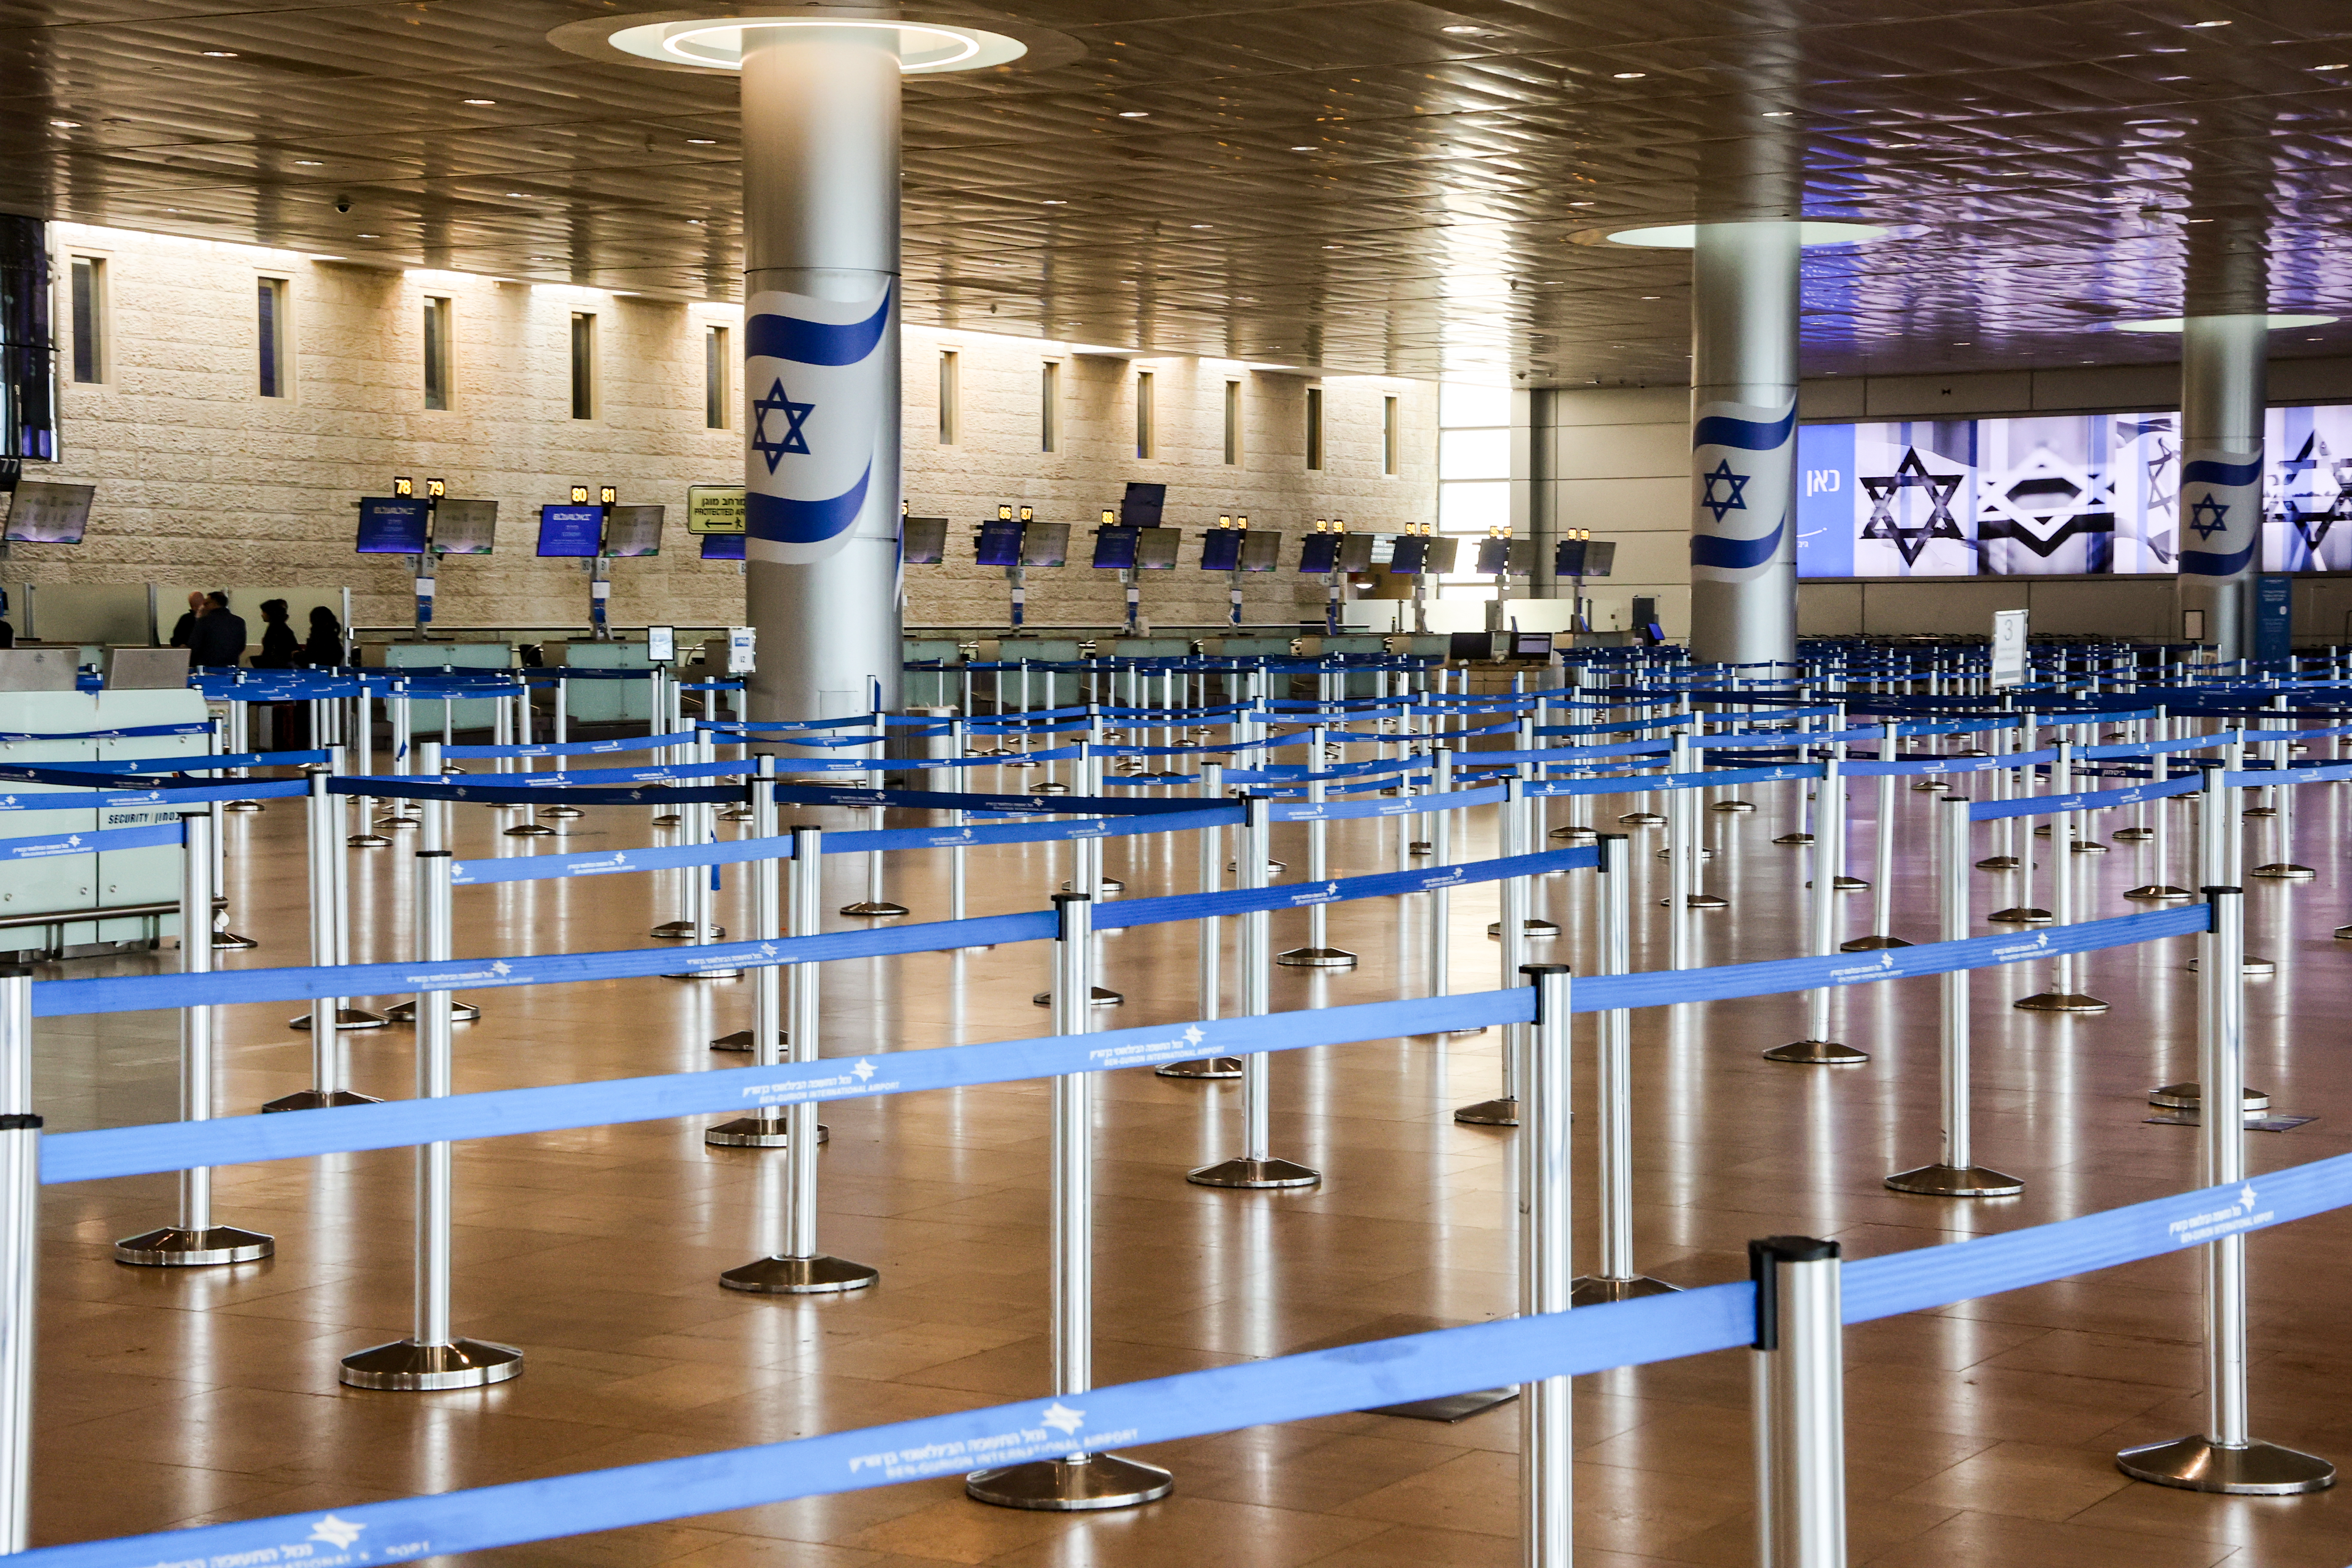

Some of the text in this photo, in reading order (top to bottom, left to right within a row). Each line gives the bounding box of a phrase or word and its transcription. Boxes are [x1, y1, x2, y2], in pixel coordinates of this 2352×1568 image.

[1, 458, 19, 473] 77
[395, 479, 411, 494] 78
[427, 481, 444, 496] 79
[1807, 470, 1840, 497] כאן
[572, 488, 587, 502] 80
[602, 488, 615, 502] 81
[901, 502, 907, 515] 5
[999, 506, 1011, 519] 86
[1021, 508, 1032, 520] 87
[1219, 516, 1230, 528] 90
[1238, 517, 1247, 529] 91
[1317, 520, 1327, 532] 92
[1406, 524, 1416, 535] 94
[1421, 524, 1430, 536] 95
[1504, 527, 1512, 538] 97
[2004, 619, 2013, 641] 3
[108, 813, 149, 824] SECURITY
[1146, 1049, 1196, 1061] INTERNATIONAL
[1197, 1046, 1225, 1055] AIRPORT
[759, 1081, 900, 1104] BEN-GURION INTERNATIONAL AIRPORT
[886, 1428, 1138, 1479] BEN-GURION INTERNATIONAL AIRPORT
